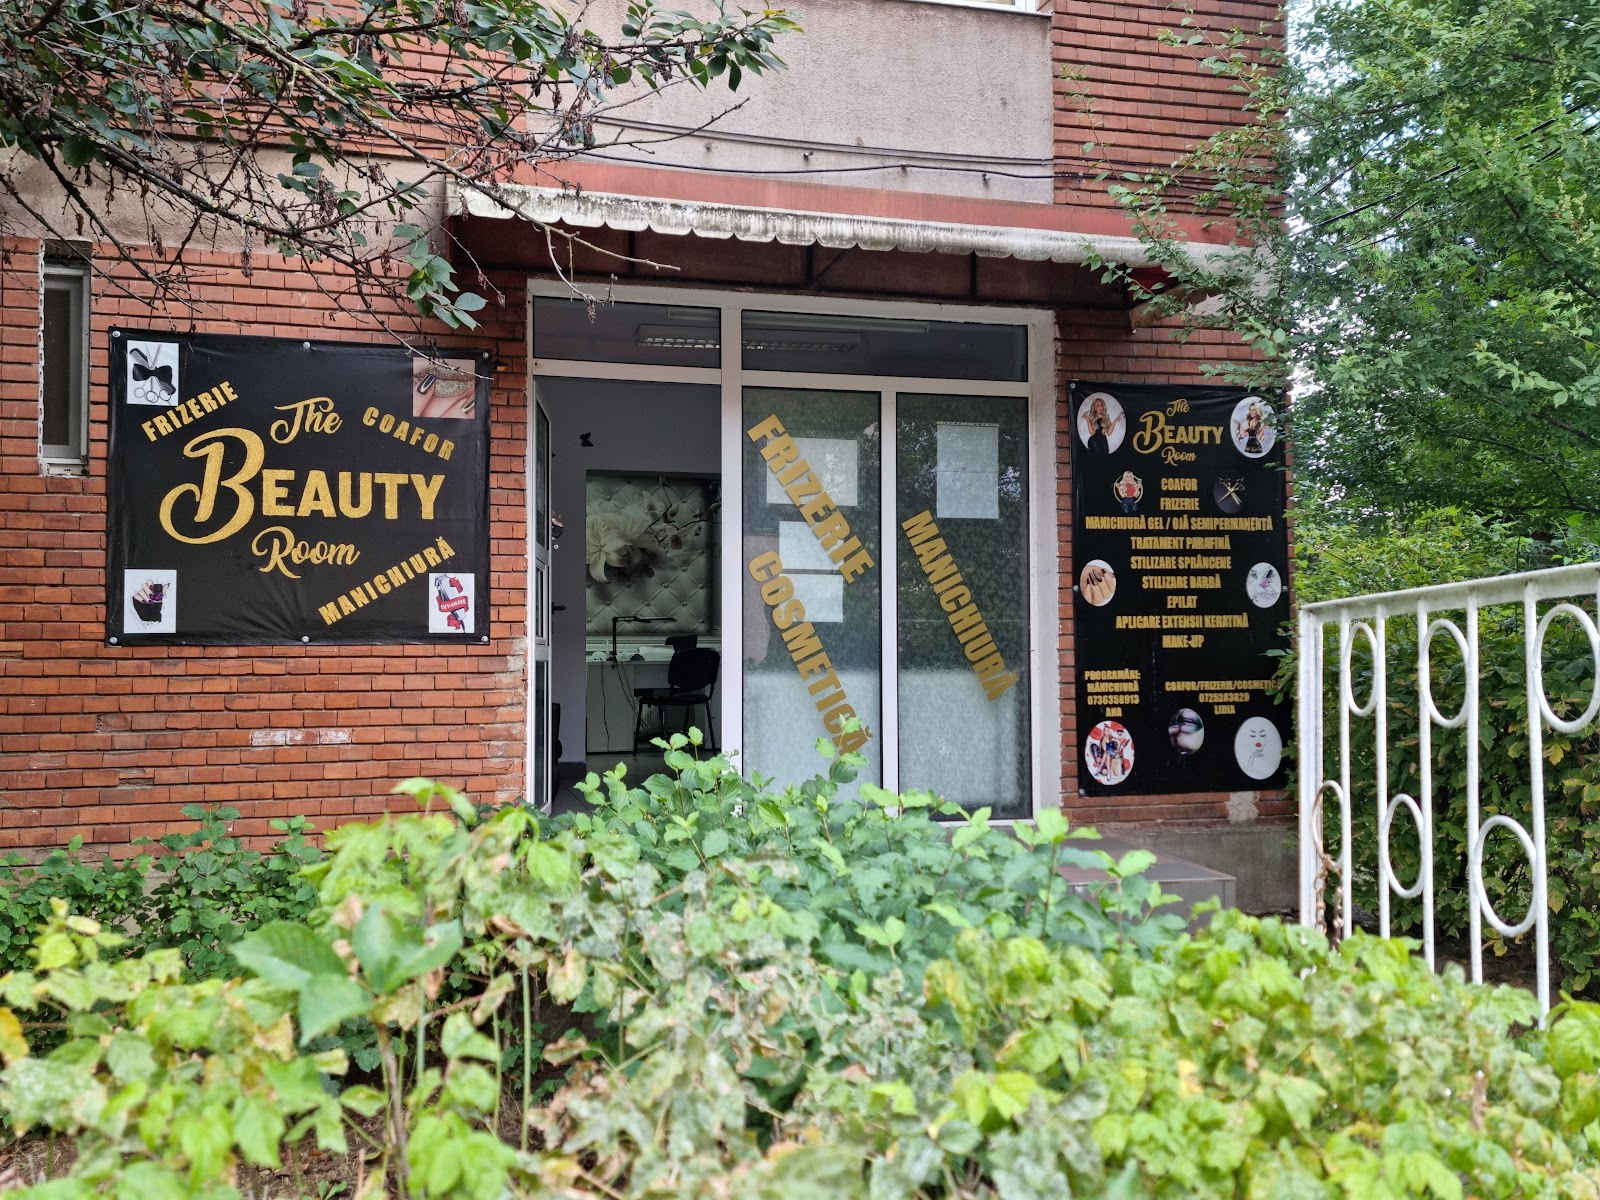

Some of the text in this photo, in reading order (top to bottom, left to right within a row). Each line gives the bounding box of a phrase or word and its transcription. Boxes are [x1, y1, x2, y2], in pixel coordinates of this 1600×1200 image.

[141, 380, 238, 442] FRIZERIE
[1166, 398, 1190, 417] The
[270, 396, 343, 444] The
[362, 406, 456, 461] COAFOR
[1132, 410, 1224, 455] BEAUTY
[1161, 445, 1197, 467] Room
[159, 427, 445, 545] BEAUTY
[1160, 477, 1198, 491] COAFOR
[747, 413, 875, 584] FRIZERIE
[1160, 497, 1200, 511] FRIZERIE
[1085, 514, 1147, 530] MANICHIURĂ
[1147, 516, 1164, 530] GEL
[1172, 514, 1190, 529] OJĂ
[252, 526, 360, 579] Room
[1130, 536, 1185, 550] TRATAMENT
[1130, 556, 1177, 570] STILIZARE
[318, 535, 456, 626] MANICHIURĂ
[1141, 575, 1188, 589] STILIZARE
[901, 509, 1020, 702] MANICHIURĂ
[1166, 595, 1198, 609] EPILAT
[1115, 615, 1161, 629] APLICARE
[1161, 615, 1203, 629] EXTENSII
[1162, 634, 1205, 648] MAKE-UP
[748, 551, 874, 758] COSMETICĂ
[1105, 706, 1123, 717] ANA
[1213, 704, 1236, 715] LIDIA
